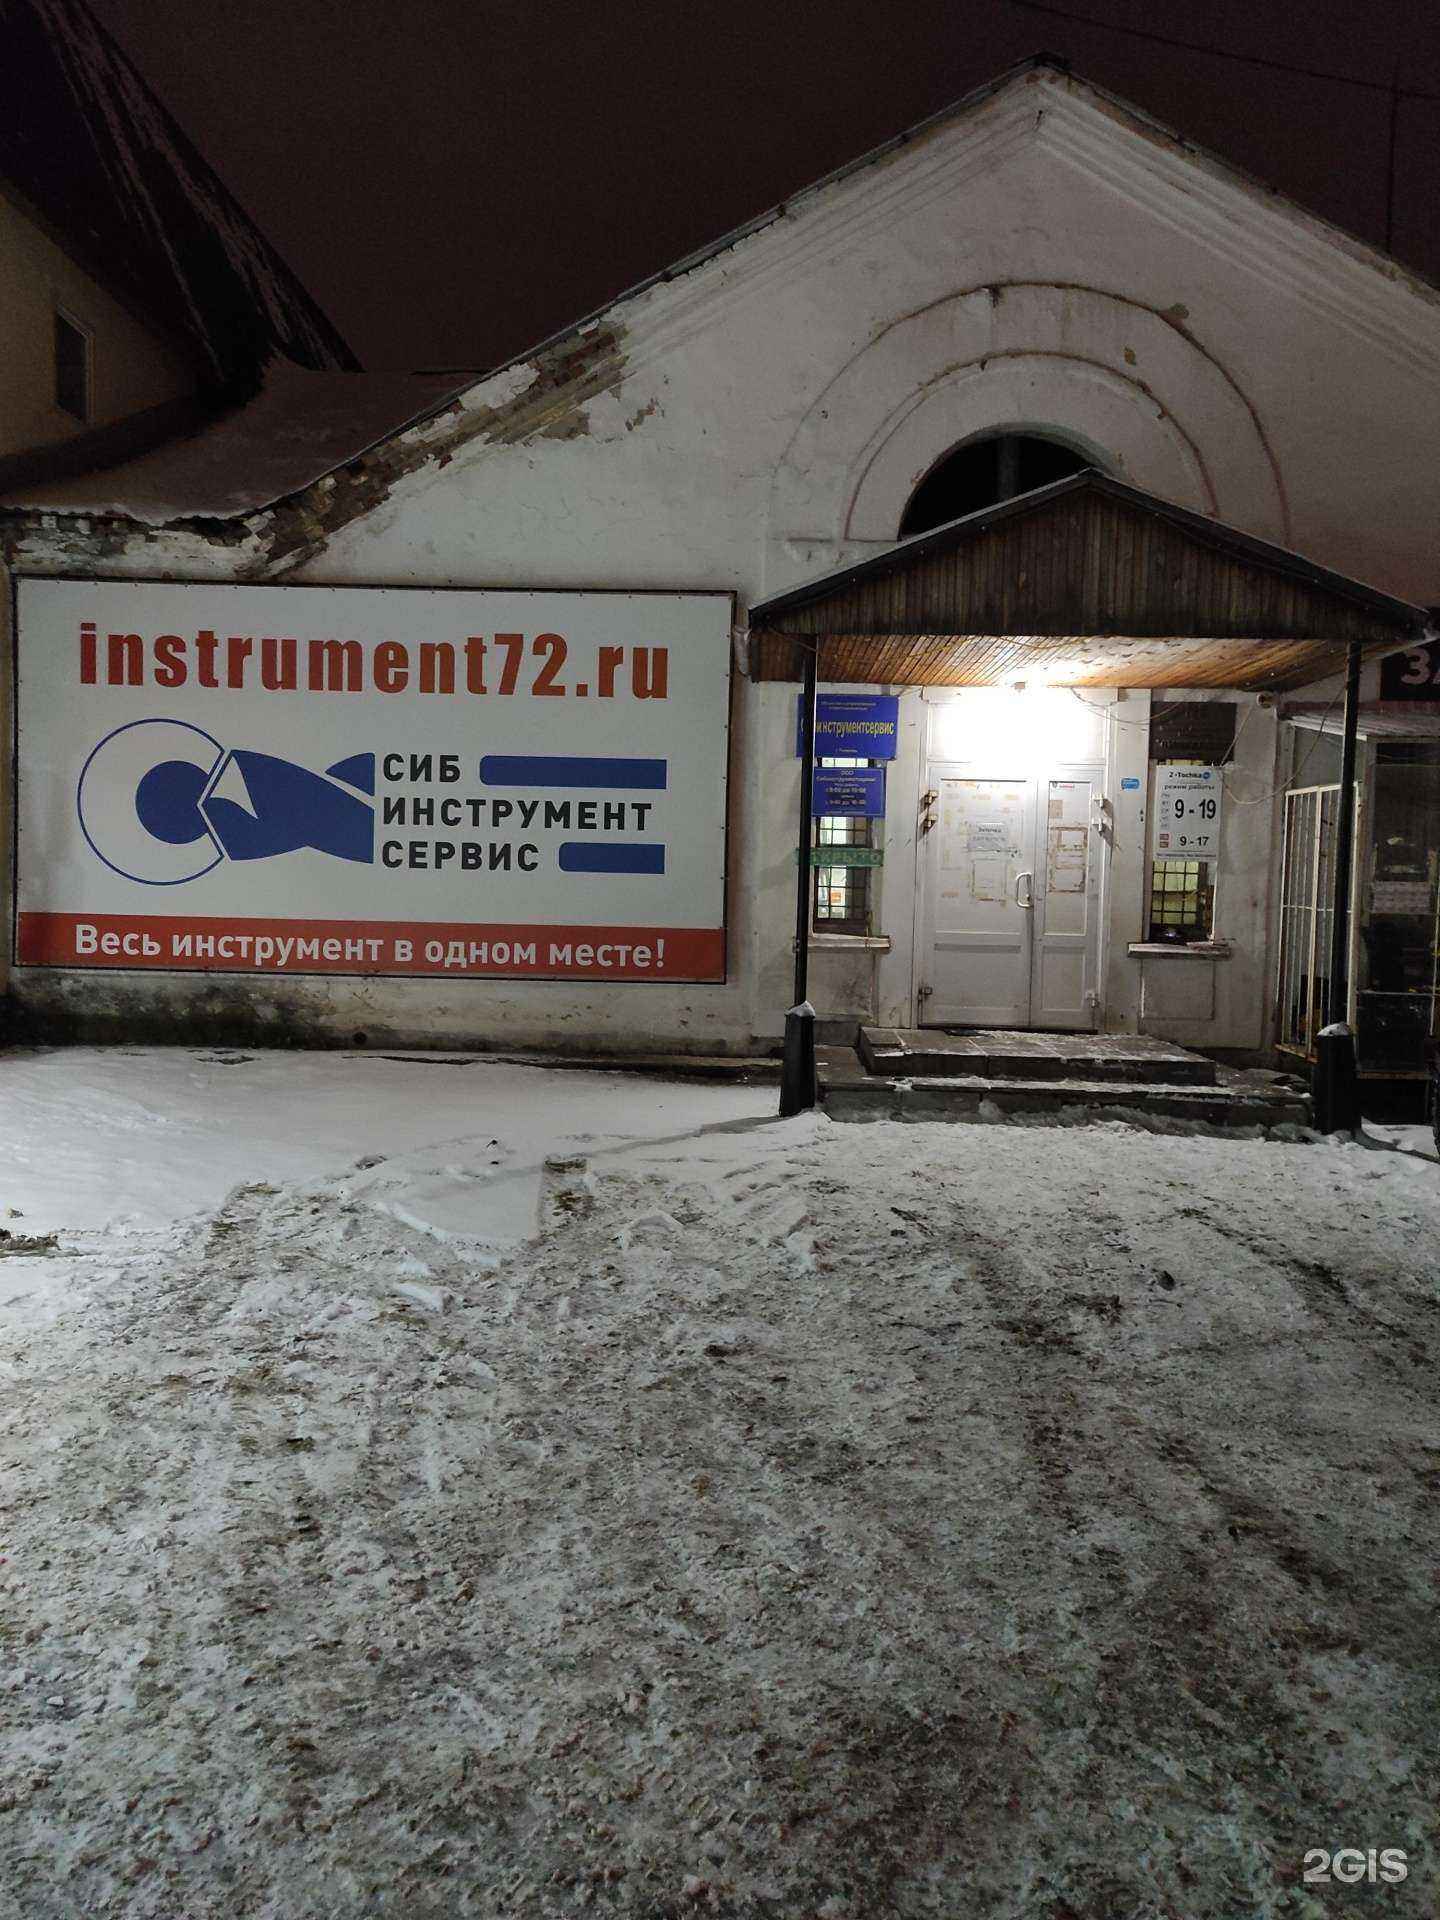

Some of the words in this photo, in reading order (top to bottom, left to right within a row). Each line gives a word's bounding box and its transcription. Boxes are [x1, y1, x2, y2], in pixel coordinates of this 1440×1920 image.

[80, 622, 669, 699] instrument72.ru
[800, 719, 894, 738] инструментсервис
[383, 754, 461, 784] СИБ
[383, 798, 653, 831] ИНСТРУМЕНТ
[1175, 799, 1184, 819] 9
[1199, 799, 1216, 819] 19
[381, 840, 540, 872] СЕРВИС
[1180, 836, 1187, 846] 9
[1197, 836, 1209, 846] 17
[75, 923, 160, 957] Весь
[172, 934, 384, 966] инструмент
[396, 941, 412, 963] в
[425, 939, 538, 972] одном
[548, 939, 666, 968] месте!
